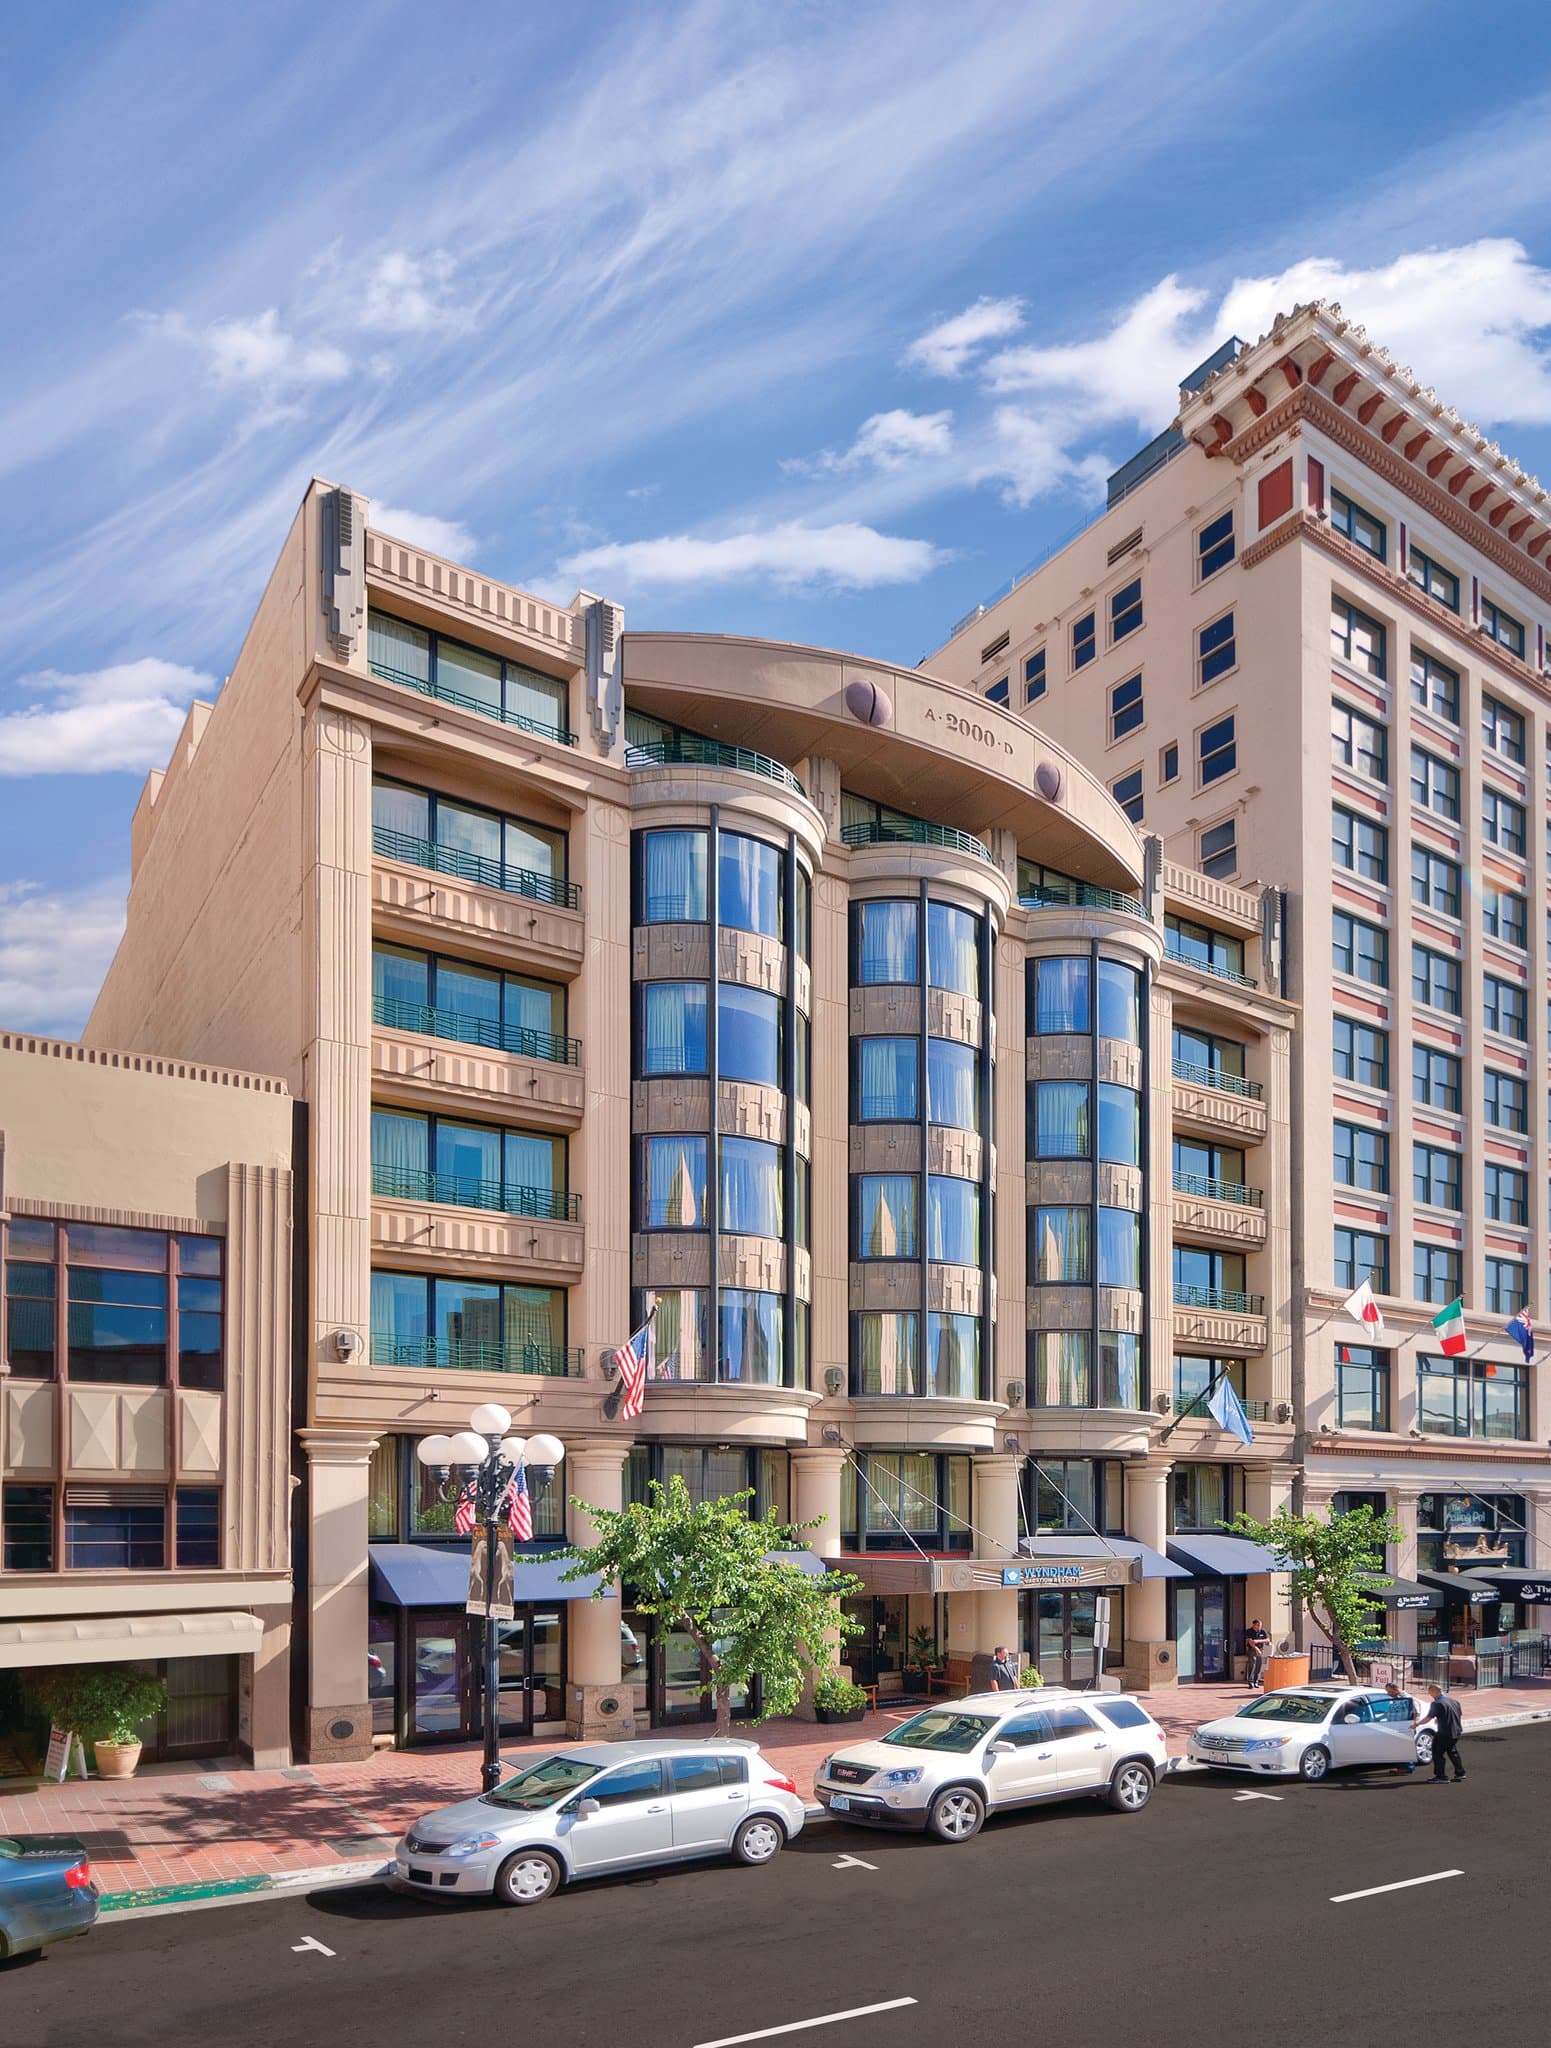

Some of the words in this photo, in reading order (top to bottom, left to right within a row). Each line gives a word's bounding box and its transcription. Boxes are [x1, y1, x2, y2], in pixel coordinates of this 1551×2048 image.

[1024, 1566, 1081, 1578] WYNDHAM
[1375, 1676, 1389, 1684] Full
[836, 1768, 858, 1778] GMC
